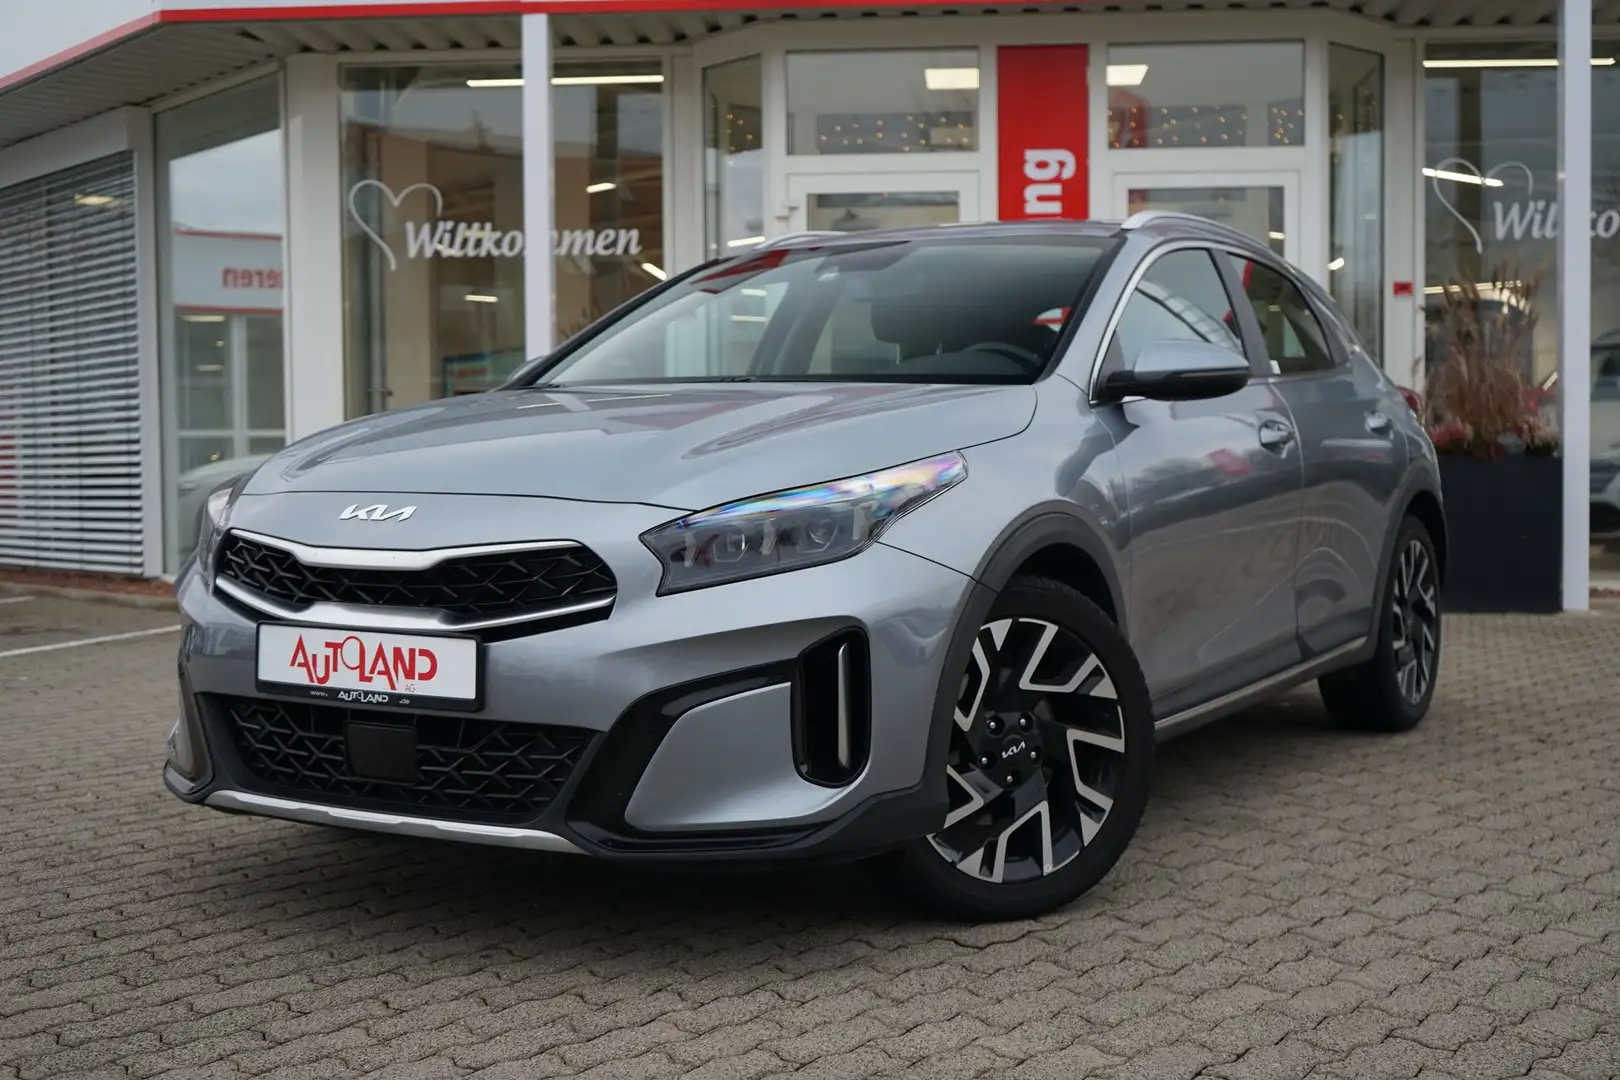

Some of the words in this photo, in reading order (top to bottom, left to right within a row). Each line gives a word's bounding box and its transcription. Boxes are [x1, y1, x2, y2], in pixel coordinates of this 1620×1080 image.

[1023, 148, 1076, 219] ng
[338, 503, 417, 522] KIA
[337, 690, 389, 703] AUTOLAND
[404, 683, 416, 693] AG
[1001, 740, 1026, 759] KIA
